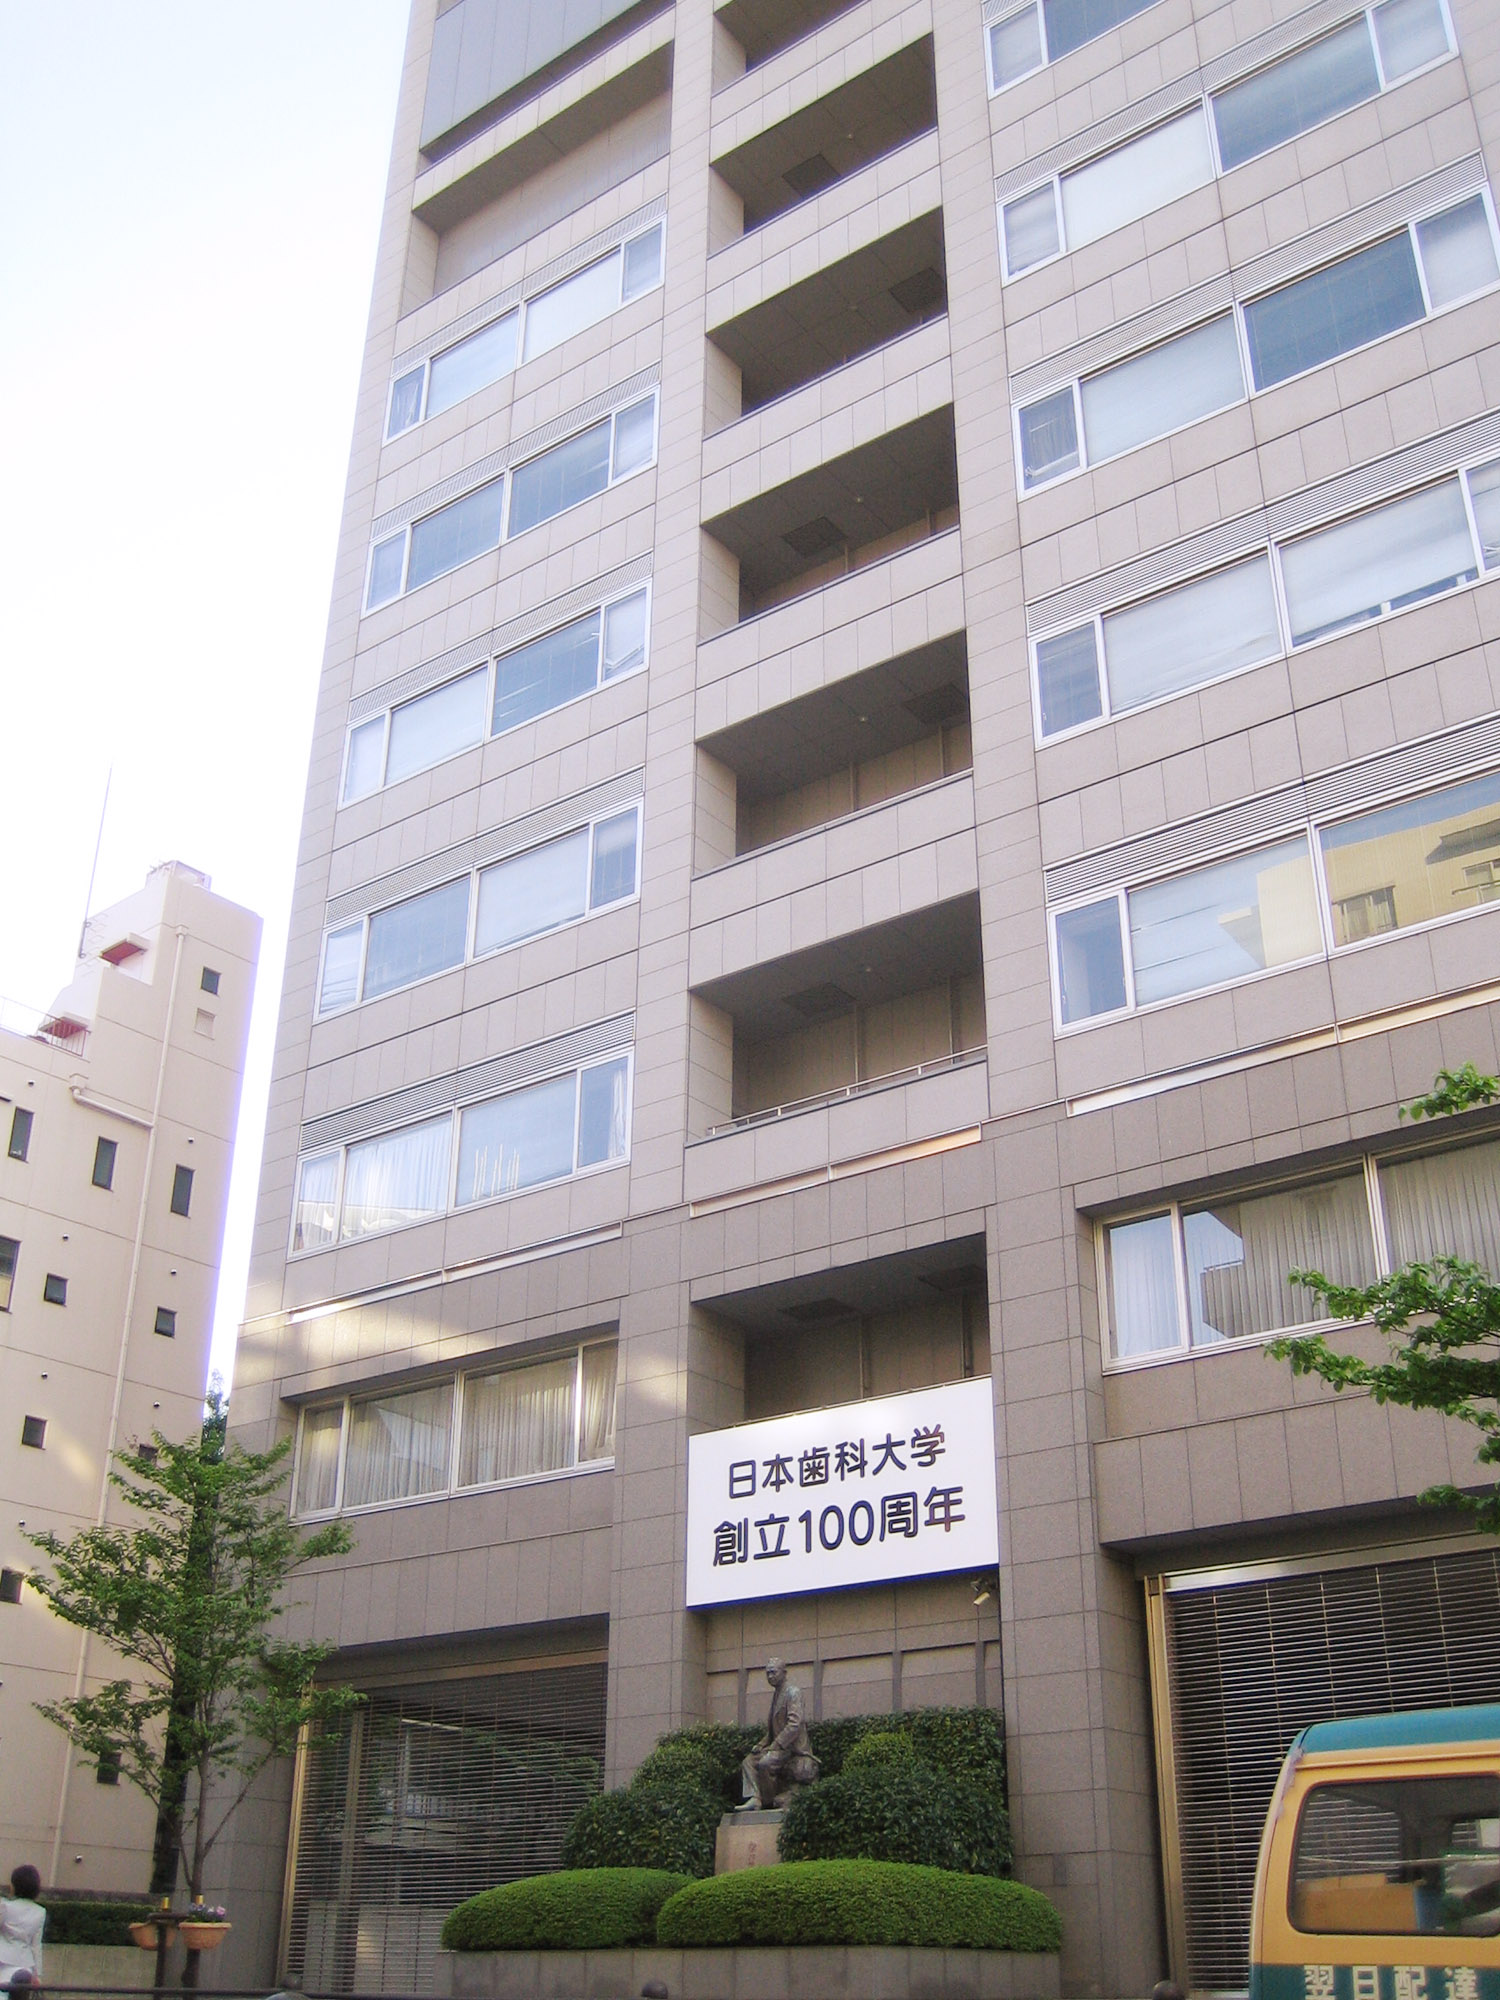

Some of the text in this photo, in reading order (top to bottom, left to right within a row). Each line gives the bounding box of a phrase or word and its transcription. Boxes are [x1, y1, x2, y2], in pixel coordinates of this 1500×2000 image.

[729, 1424, 946, 1499] 日本歯科大学
[713, 1486, 966, 1567] 創立100周年
